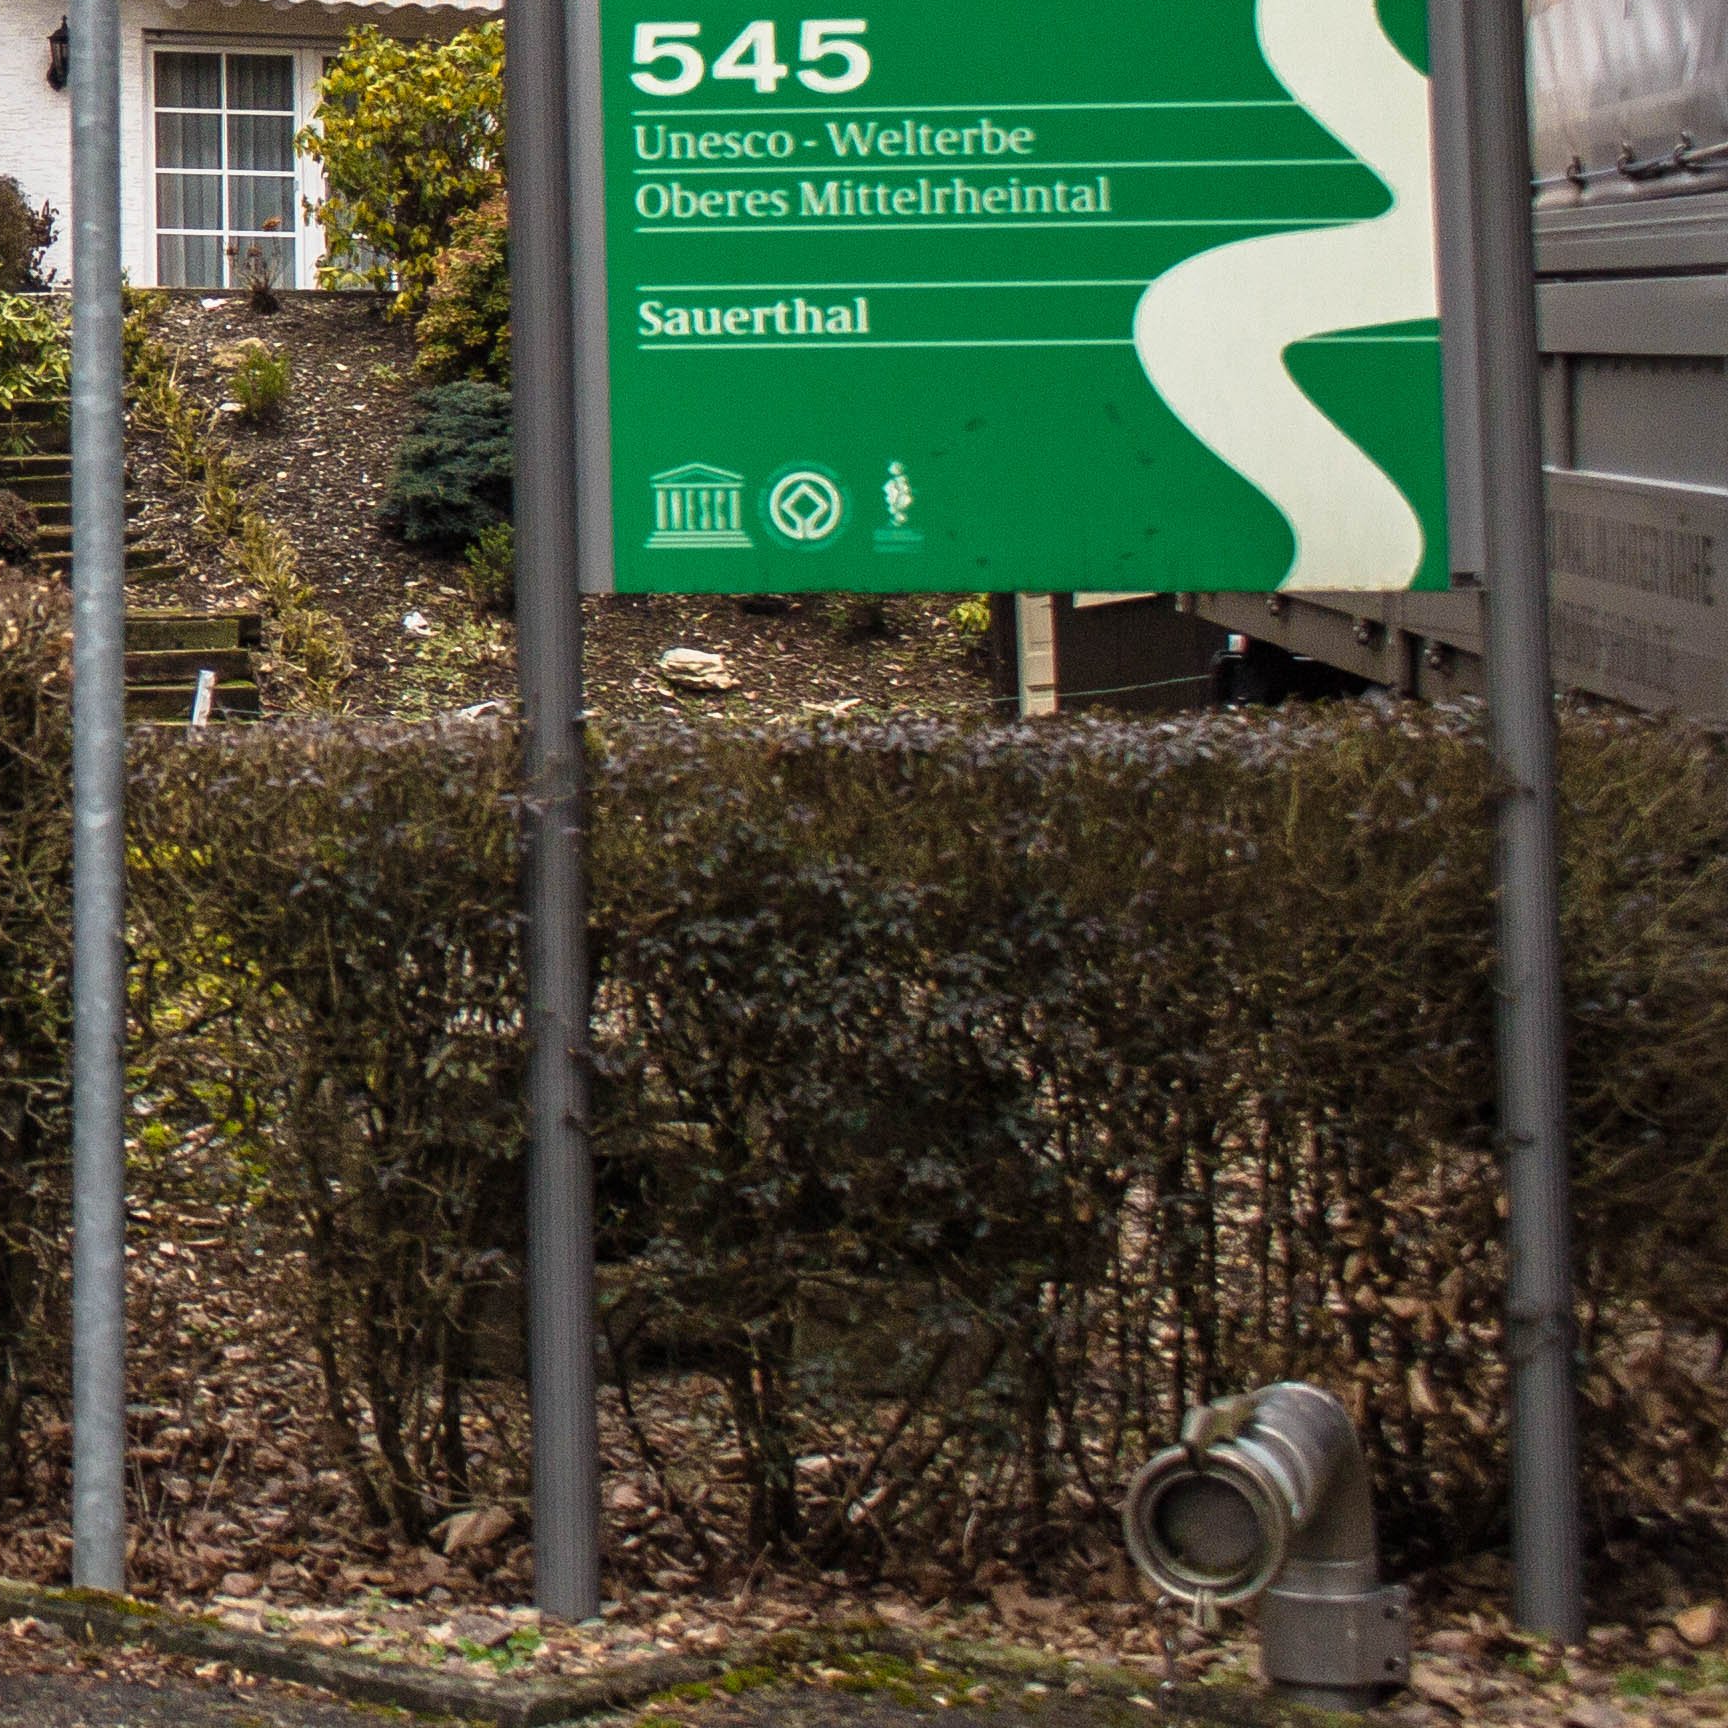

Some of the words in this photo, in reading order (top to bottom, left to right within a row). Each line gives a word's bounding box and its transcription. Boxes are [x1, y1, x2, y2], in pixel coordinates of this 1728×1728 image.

[629, 18, 872, 97] 545
[634, 125, 795, 160] Unesco
[826, 119, 1035, 157] Welterbe
[635, 182, 790, 218] Oberes
[800, 176, 1111, 217] Mittelrheintal
[638, 297, 870, 337] Sauerthal
